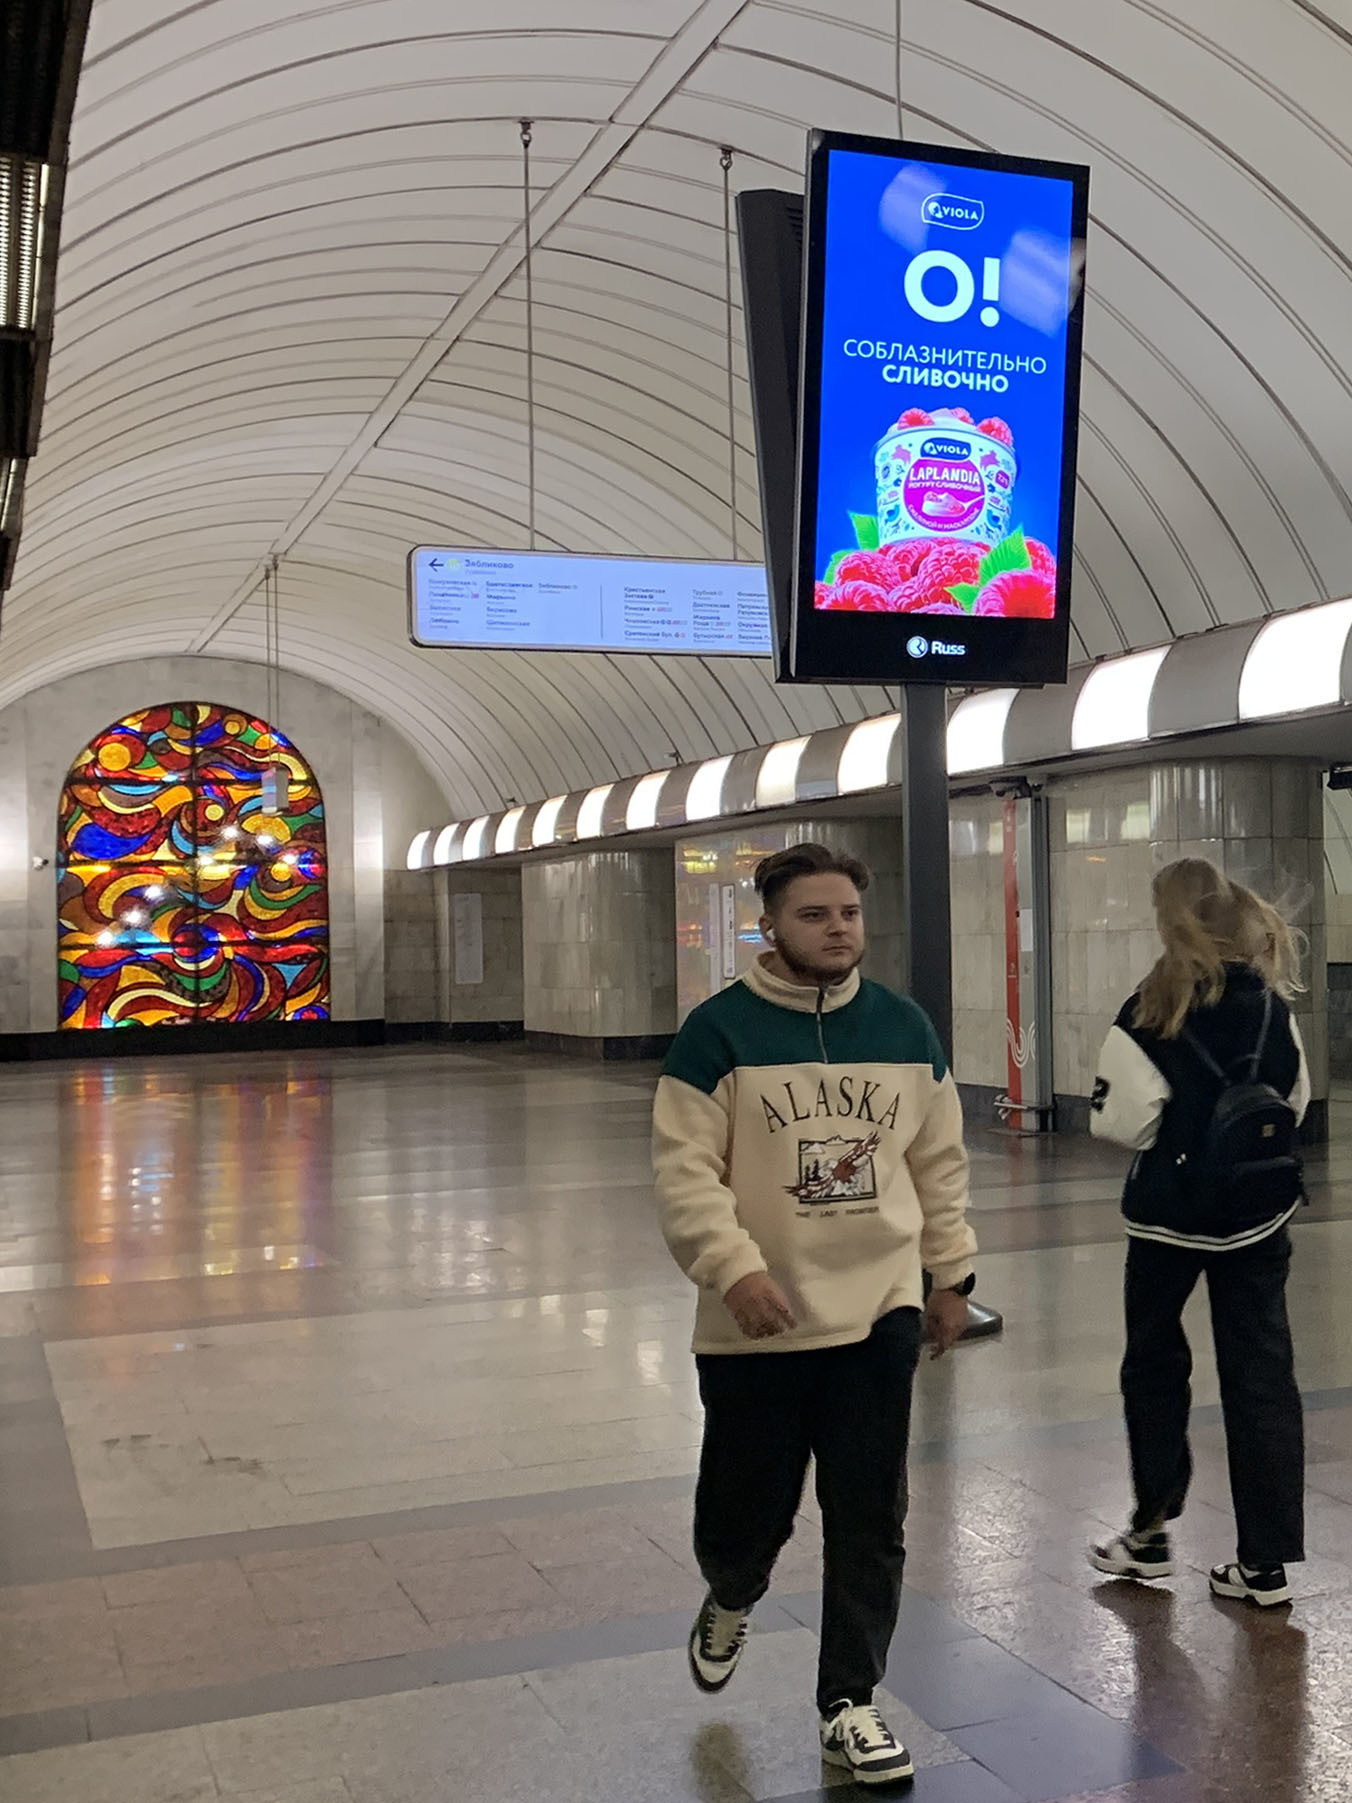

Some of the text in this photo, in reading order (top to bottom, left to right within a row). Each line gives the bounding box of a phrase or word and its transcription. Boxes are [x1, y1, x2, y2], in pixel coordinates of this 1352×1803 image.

[942, 206, 979, 220] VIOLA
[904, 249, 1000, 328] О!
[843, 338, 1047, 375] СОБЛАЗНИТЕЛЬНО
[882, 364, 1009, 393] СЛИВОЧНО
[936, 444, 969, 456] VIOLA
[909, 466, 981, 485] LAPLANDIA
[931, 640, 966, 656] Russ
[760, 1075, 900, 1133] ALASKA
